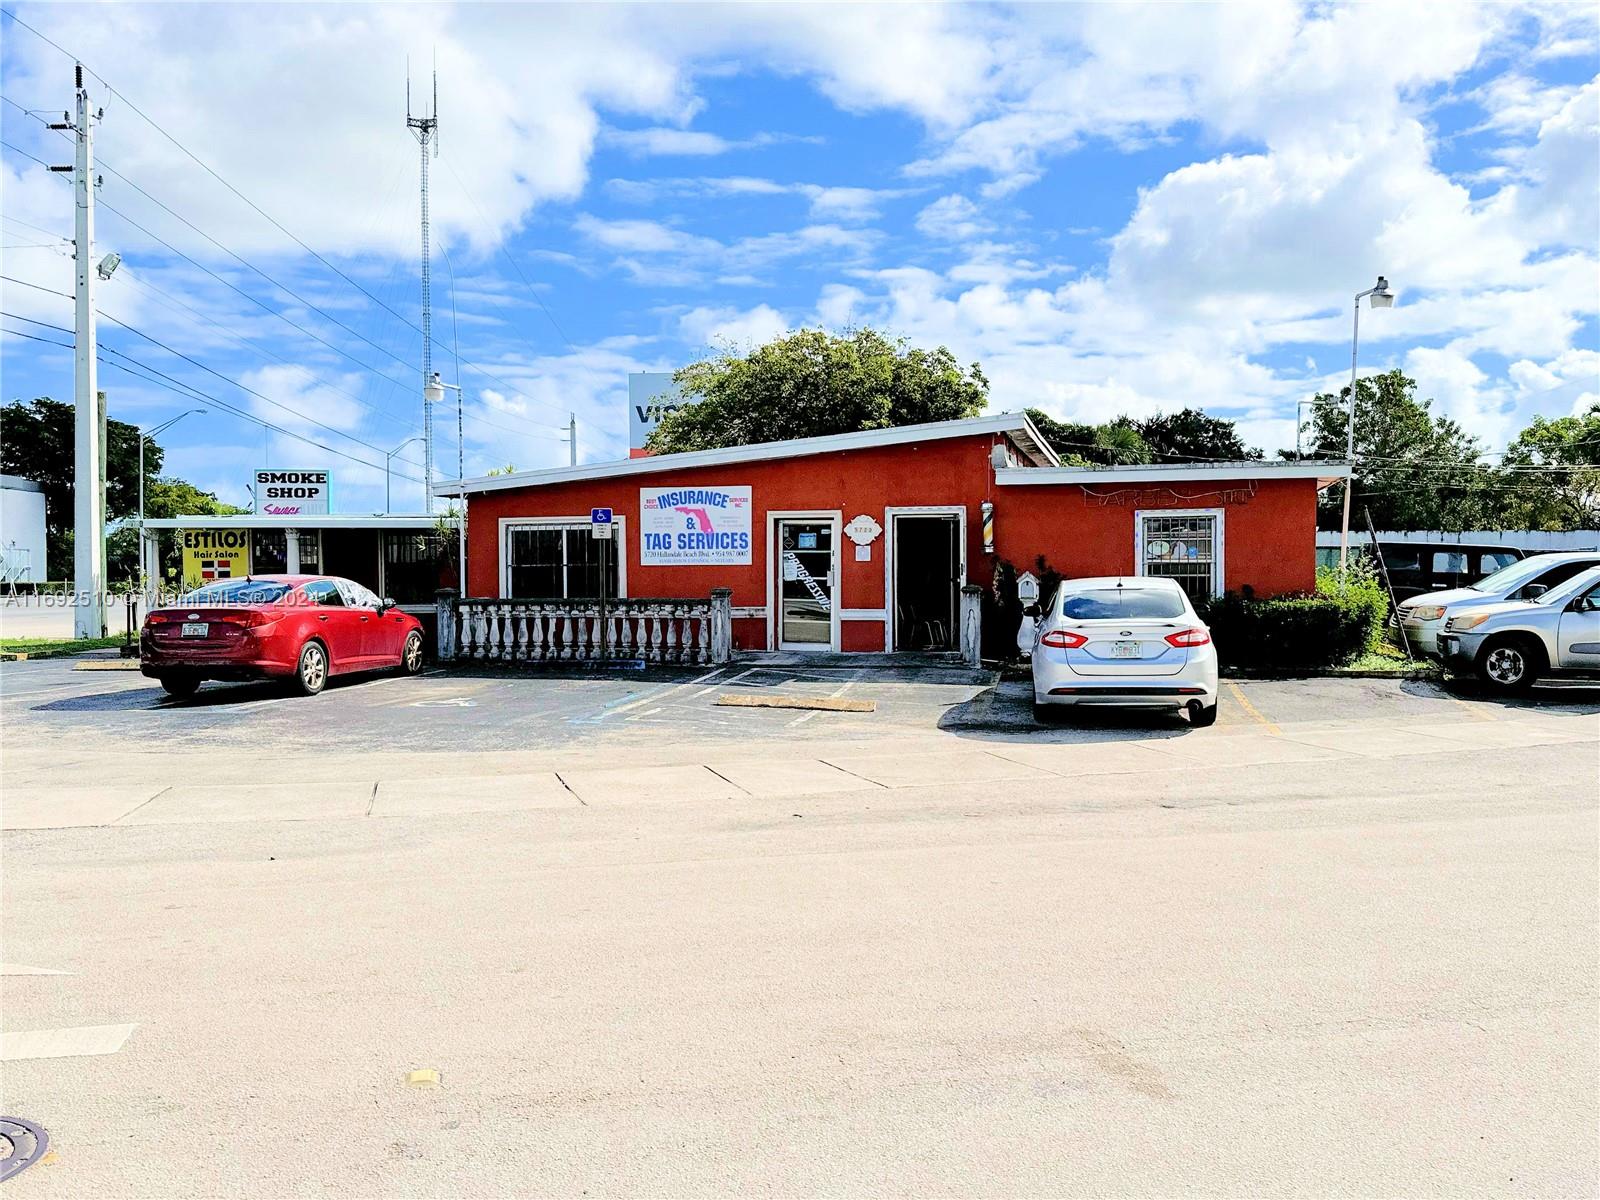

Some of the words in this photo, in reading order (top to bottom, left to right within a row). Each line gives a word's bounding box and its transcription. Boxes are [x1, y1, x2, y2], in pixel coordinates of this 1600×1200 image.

[257, 472, 327, 484] SMOKE
[266, 487, 320, 499] SHOP
[657, 490, 730, 510] INSURANCE
[686, 517, 697, 530] &
[184, 530, 247, 549] ESTILOS
[644, 533, 672, 550] TAG
[677, 532, 749, 550] SERVICES
[193, 551, 213, 559] Hair
[214, 550, 239, 559] Salon
[657, 550, 682, 558] Hallandale
[682, 550, 697, 558] Beach
[783, 552, 831, 610] PROGRESSIVE
